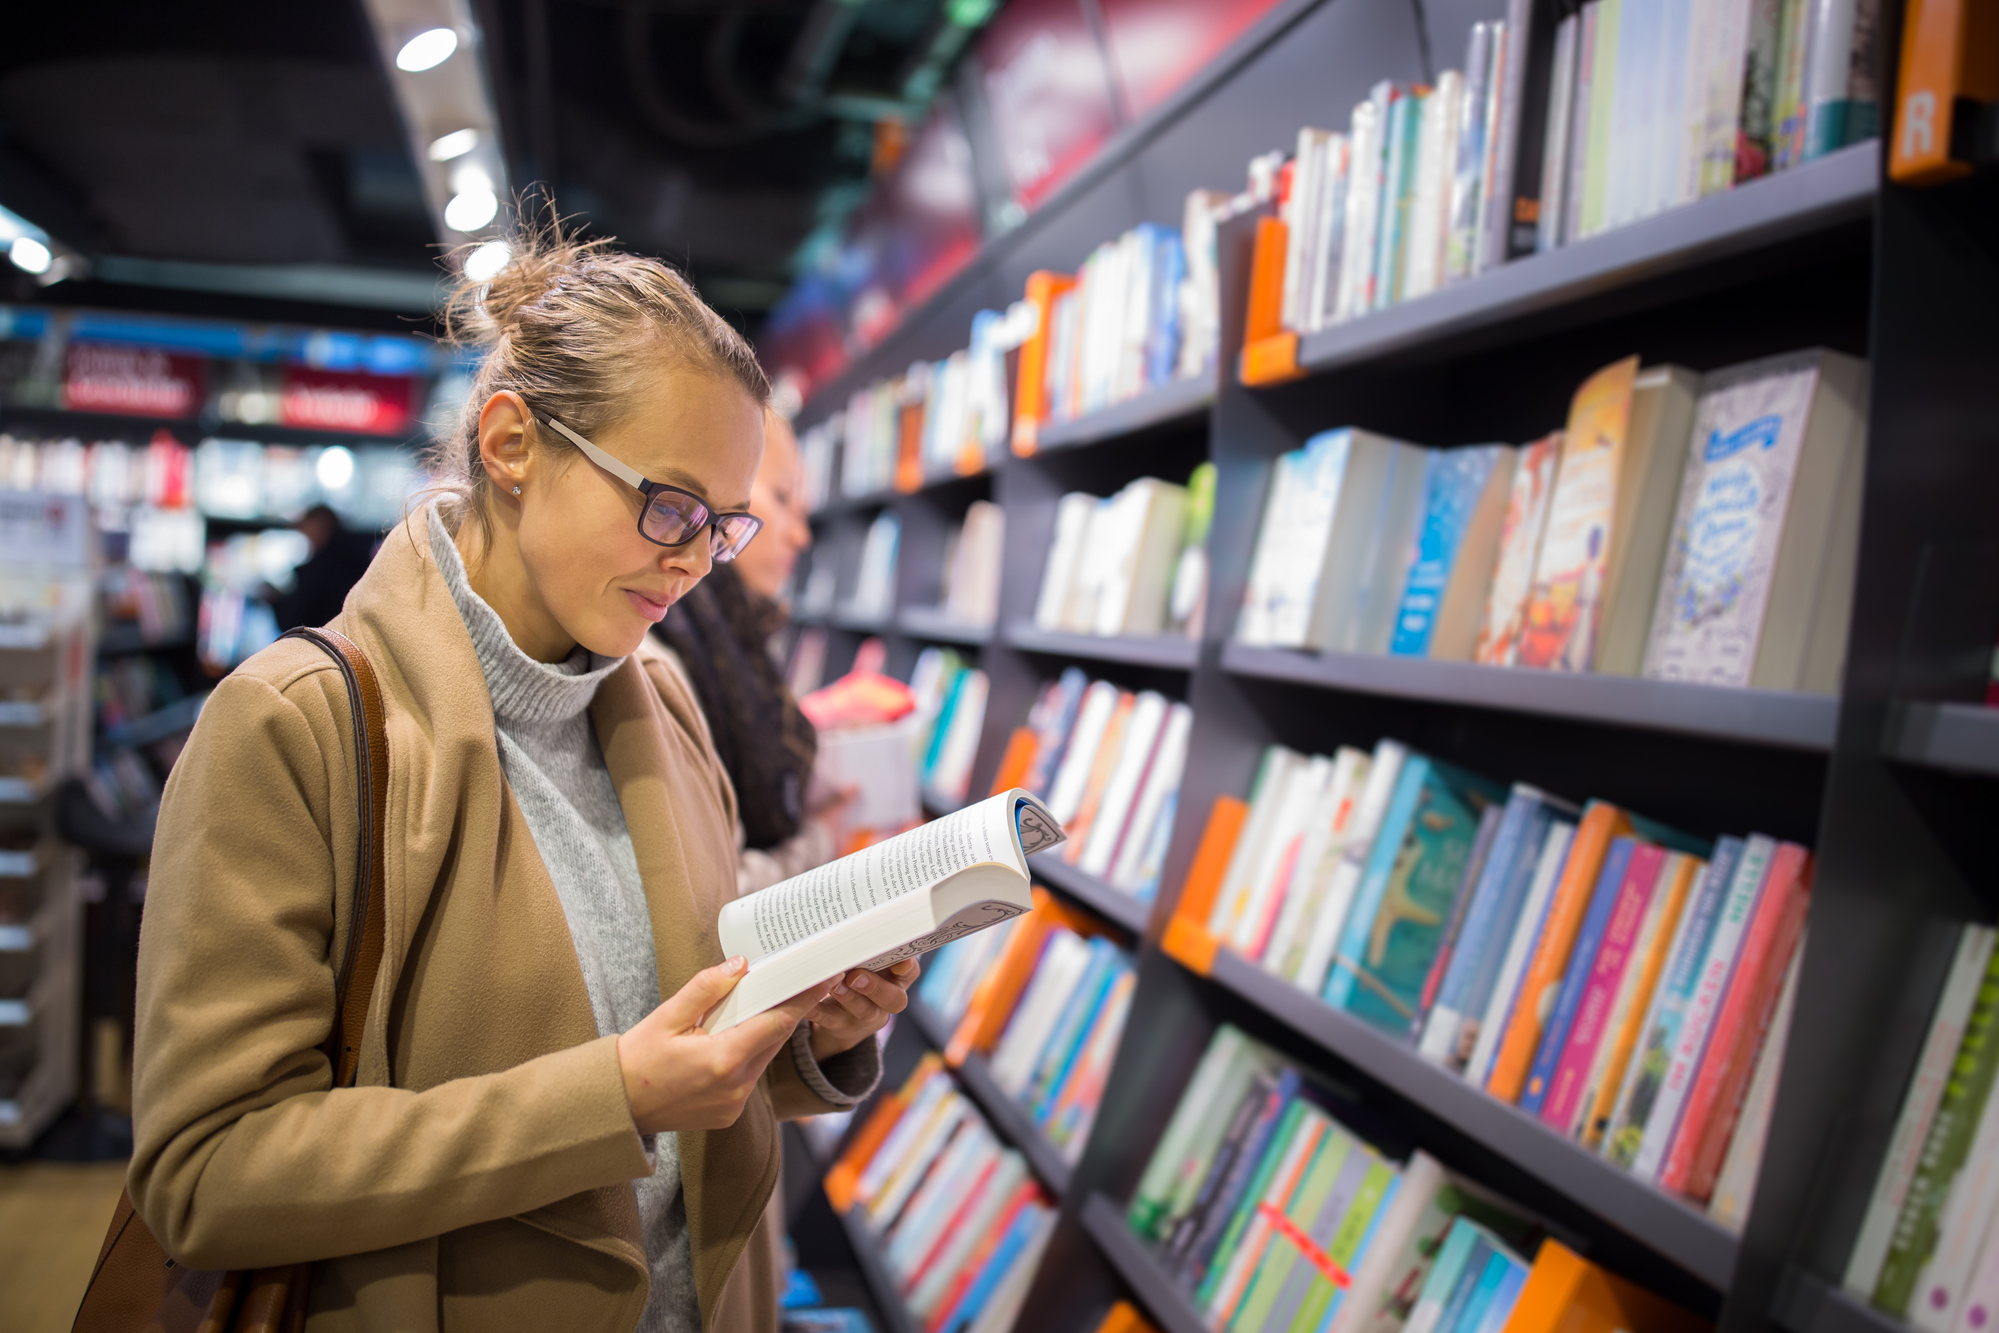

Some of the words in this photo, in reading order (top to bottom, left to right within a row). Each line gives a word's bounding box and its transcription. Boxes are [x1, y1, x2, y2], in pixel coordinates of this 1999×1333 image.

[1904, 91, 1936, 157] R
[912, 858, 920, 880] Portion
[921, 862, 929, 882] diesen
